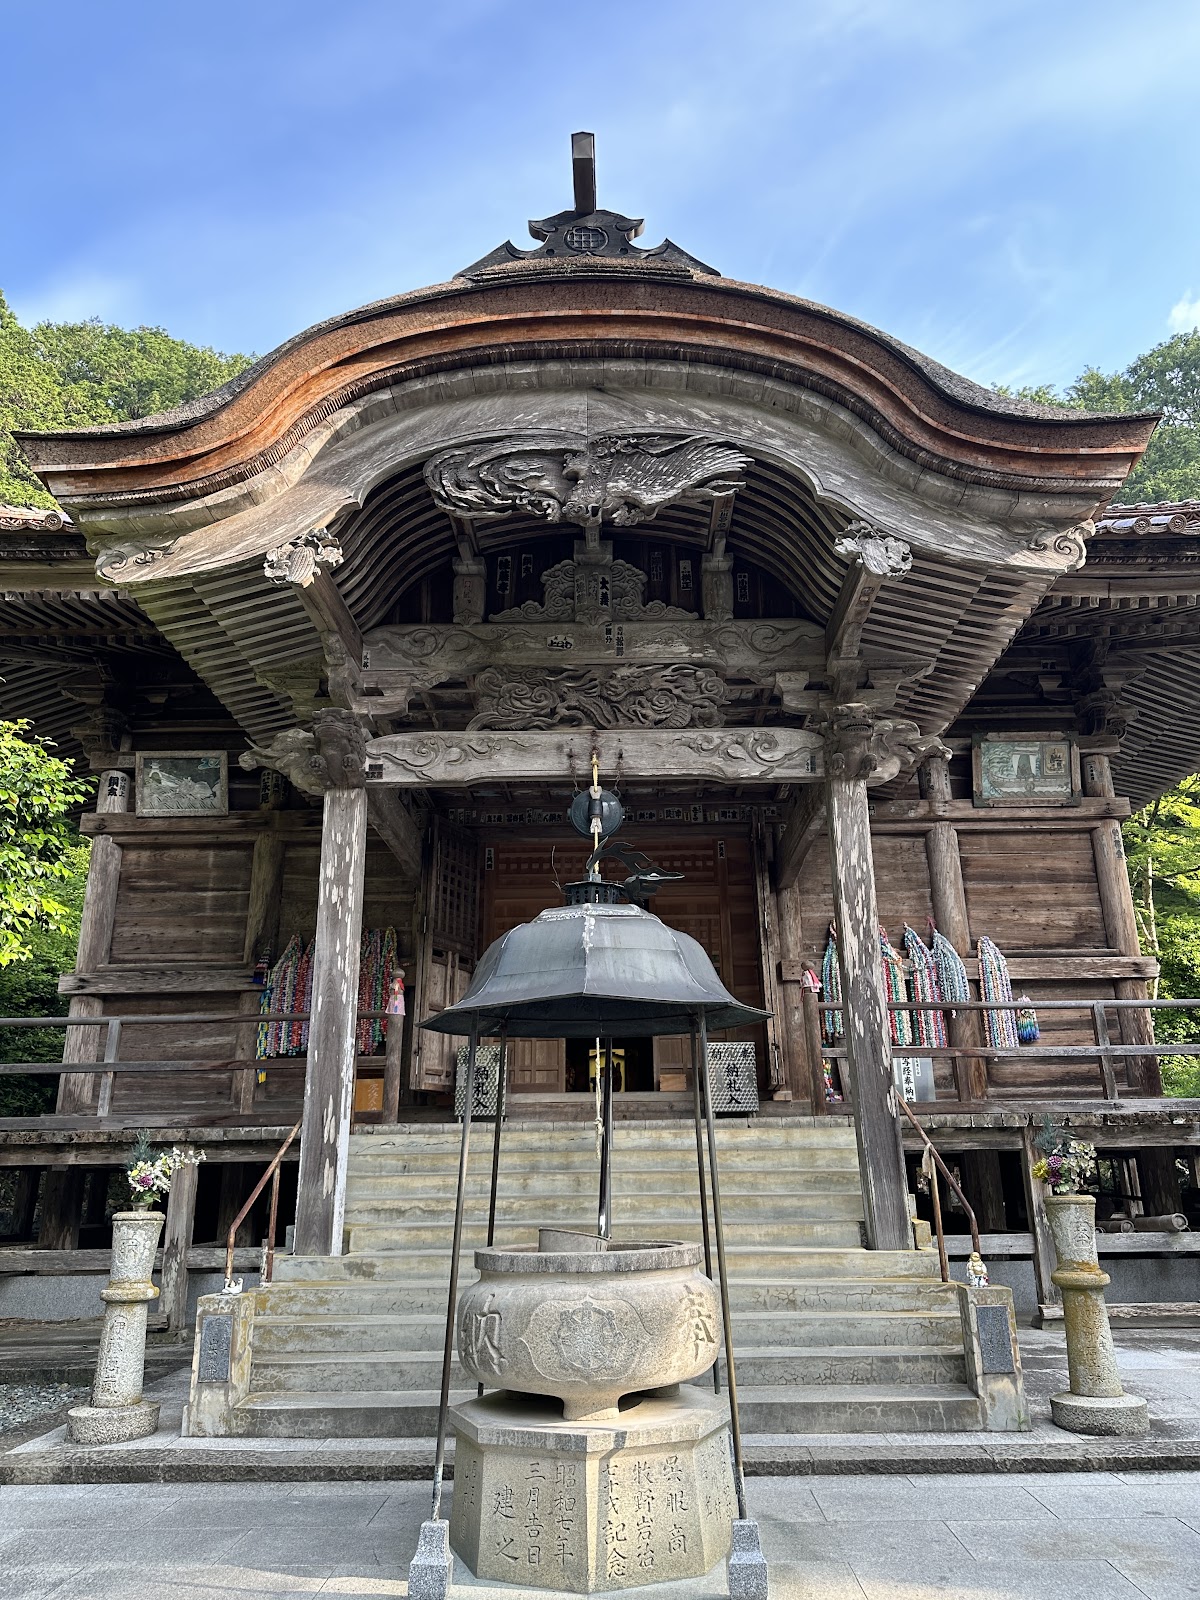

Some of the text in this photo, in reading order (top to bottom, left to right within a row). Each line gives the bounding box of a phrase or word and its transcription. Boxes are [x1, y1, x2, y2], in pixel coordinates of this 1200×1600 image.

[473, 1066, 489, 1108] 納札入
[726, 1063, 742, 1105] 納札入
[492, 1484, 519, 1563] 建之
[524, 1461, 546, 1566] 三月吉日
[554, 1464, 576, 1566] 昭和七年
